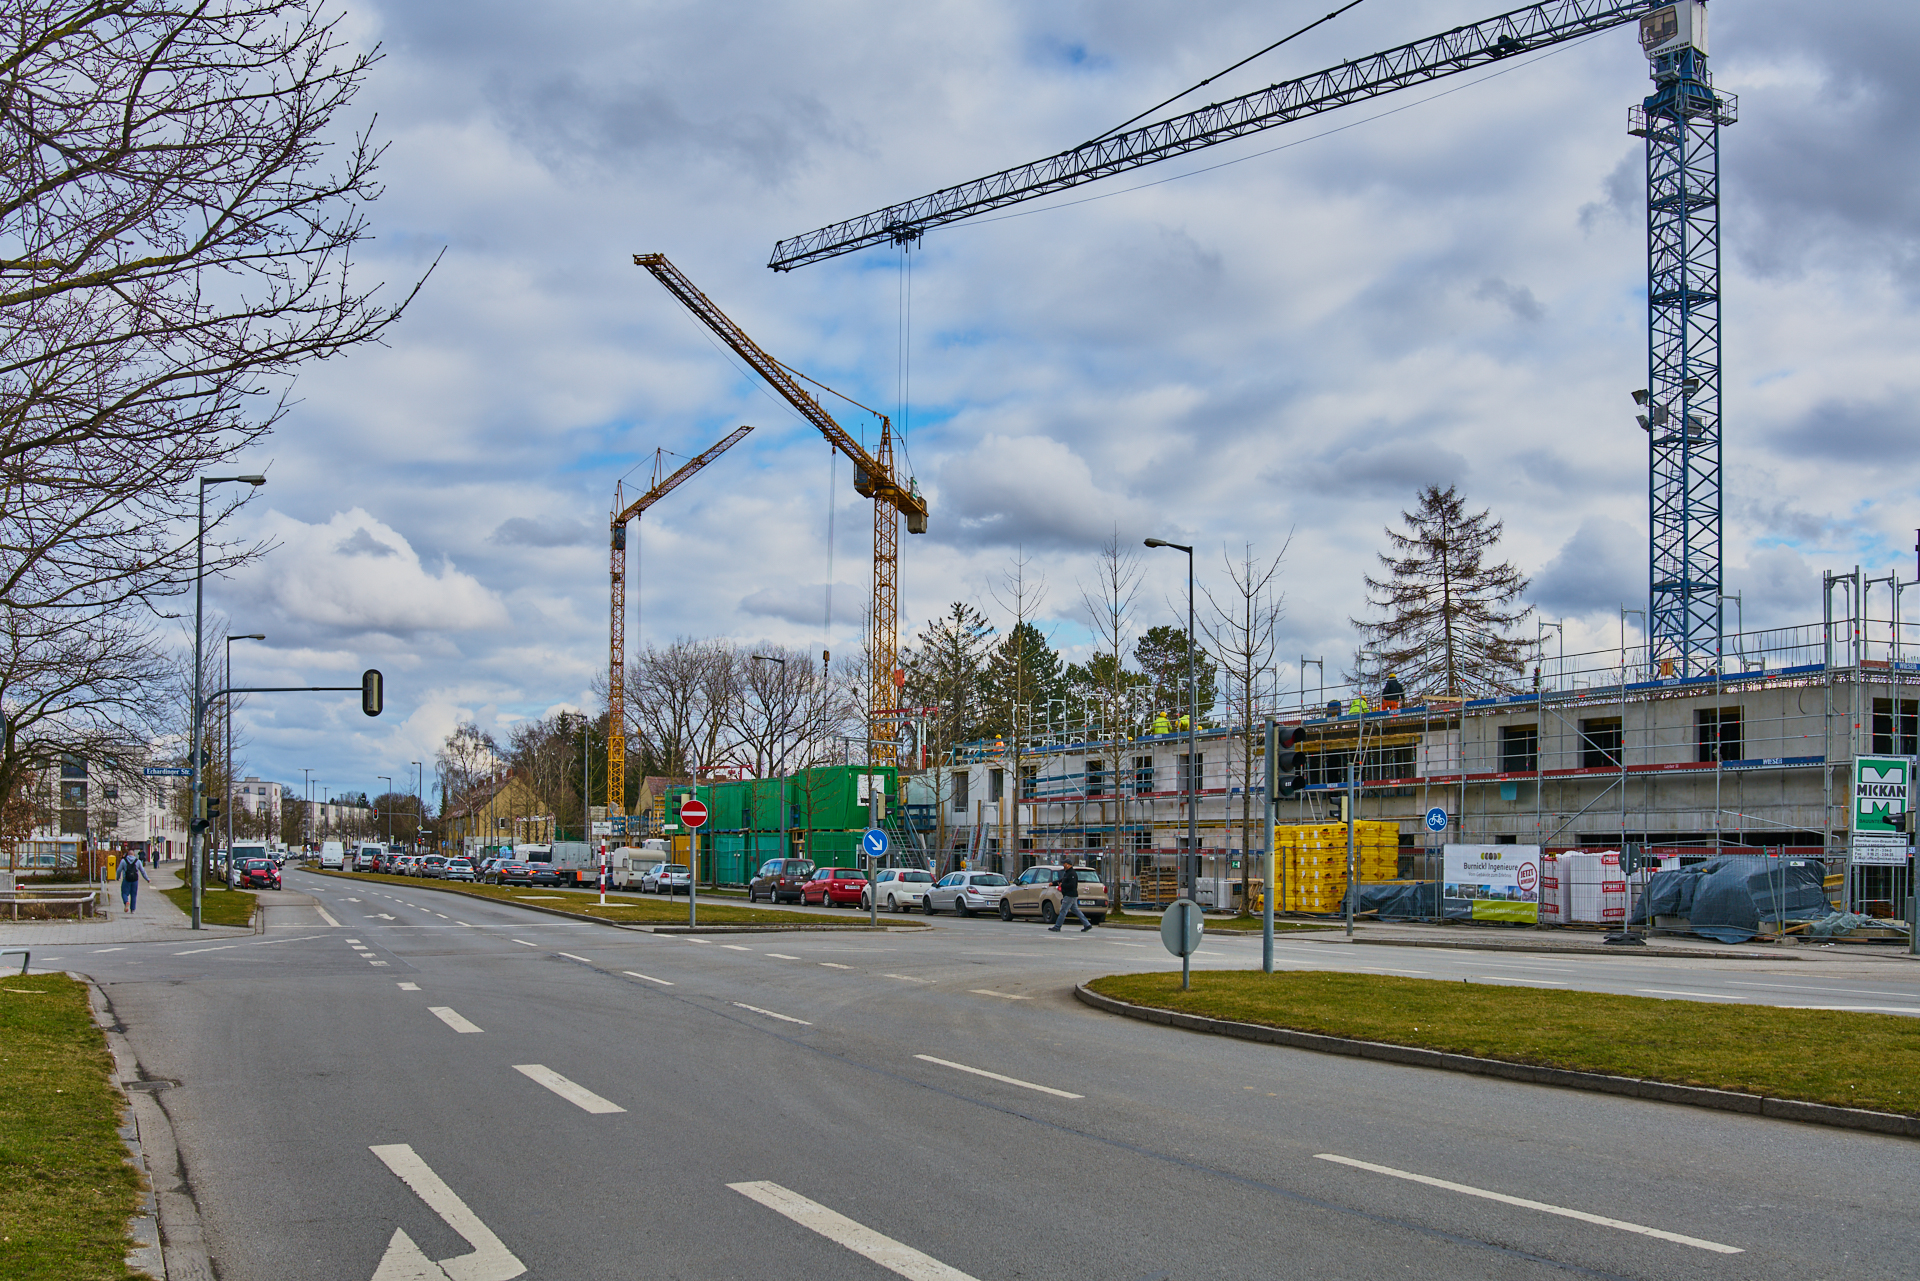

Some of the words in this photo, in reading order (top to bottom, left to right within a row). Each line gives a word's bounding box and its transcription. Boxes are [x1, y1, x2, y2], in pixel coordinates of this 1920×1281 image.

[1900, 662, 1917, 670] WIESER
[1762, 668, 1782, 676] WIESER
[1857, 784, 1906, 797] MICKAN
[1464, 862, 1487, 870] Burnickl
[1488, 862, 1518, 872] Ingenieure
[1520, 868, 1534, 878] JETZT
